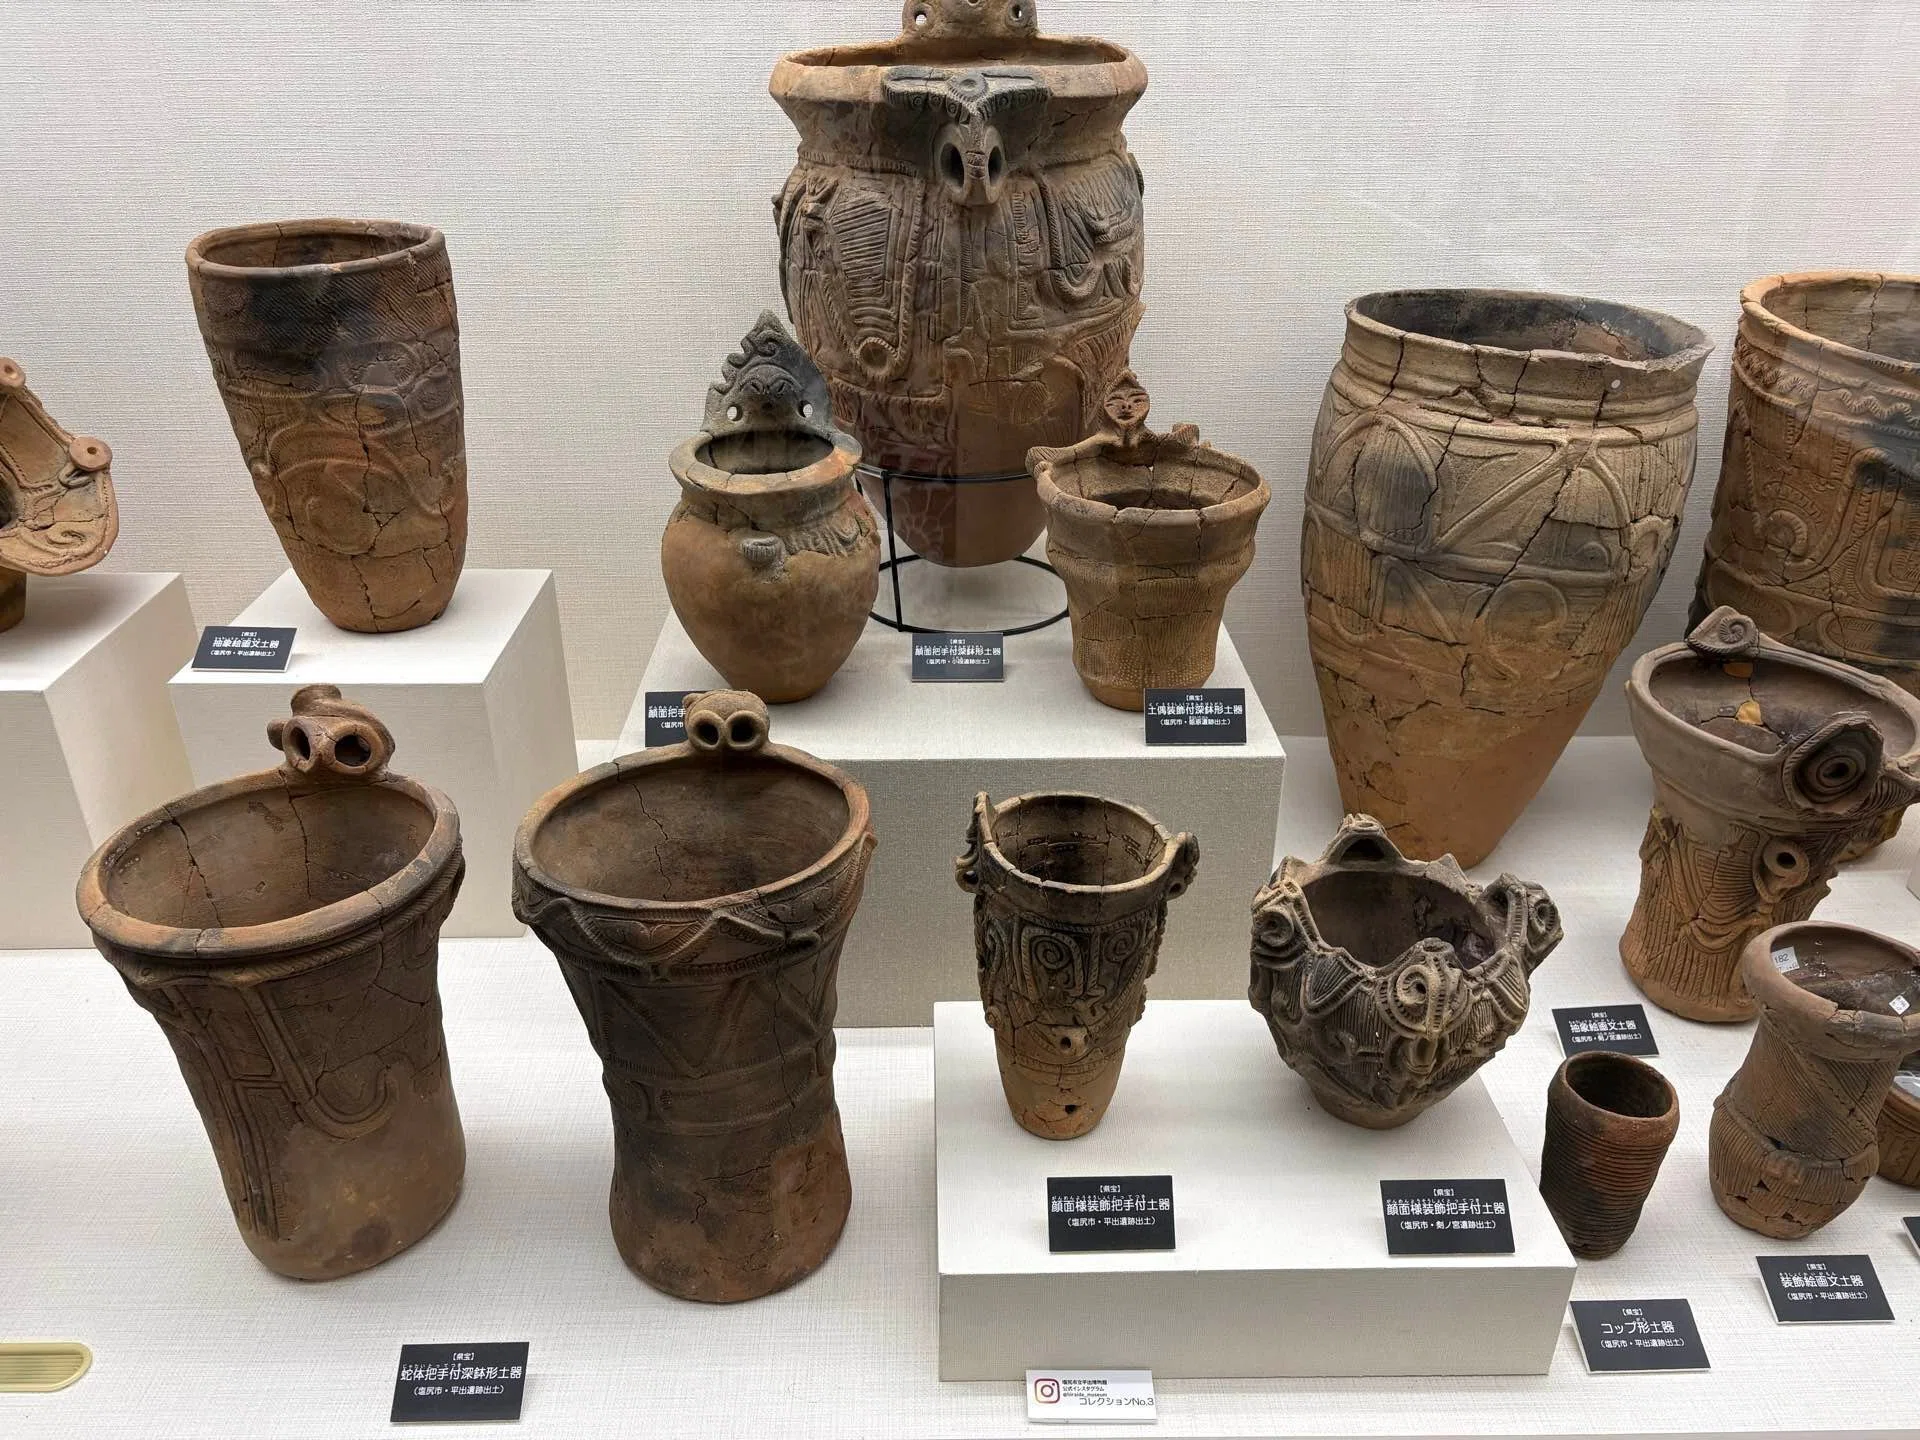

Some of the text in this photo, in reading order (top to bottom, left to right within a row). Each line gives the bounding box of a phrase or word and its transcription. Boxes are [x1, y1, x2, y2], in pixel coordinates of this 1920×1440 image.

[212, 639, 279, 649] 抽象絵画文土器
[914, 647, 1001, 656] 顔面把手付深鉢形土器
[1147, 705, 1243, 715] 土偶装飾付深鉢形土器
[1569, 1020, 1637, 1033] 抽象絵画文土器
[1051, 1199, 1171, 1213] 顔面様装飾把手付土器
[1386, 1202, 1506, 1216] 顔面様装飾把手付土器
[1067, 1216, 1156, 1227] （塩尻市・平出遺跡出土）
[1780, 1275, 1864, 1288] 装飾絵画文土器
[1787, 1291, 1868, 1301] （塩尻市・平出遺跡出土）
[1600, 1321, 1675, 1334] コップ形土器
[1600, 1338, 1685, 1348] （塩尻市・平出遺跡出土）
[400, 1367, 523, 1381] 蛇体把手付深鉢形土器
[413, 1385, 505, 1396] （塩尻市・平出遺跡出土）
